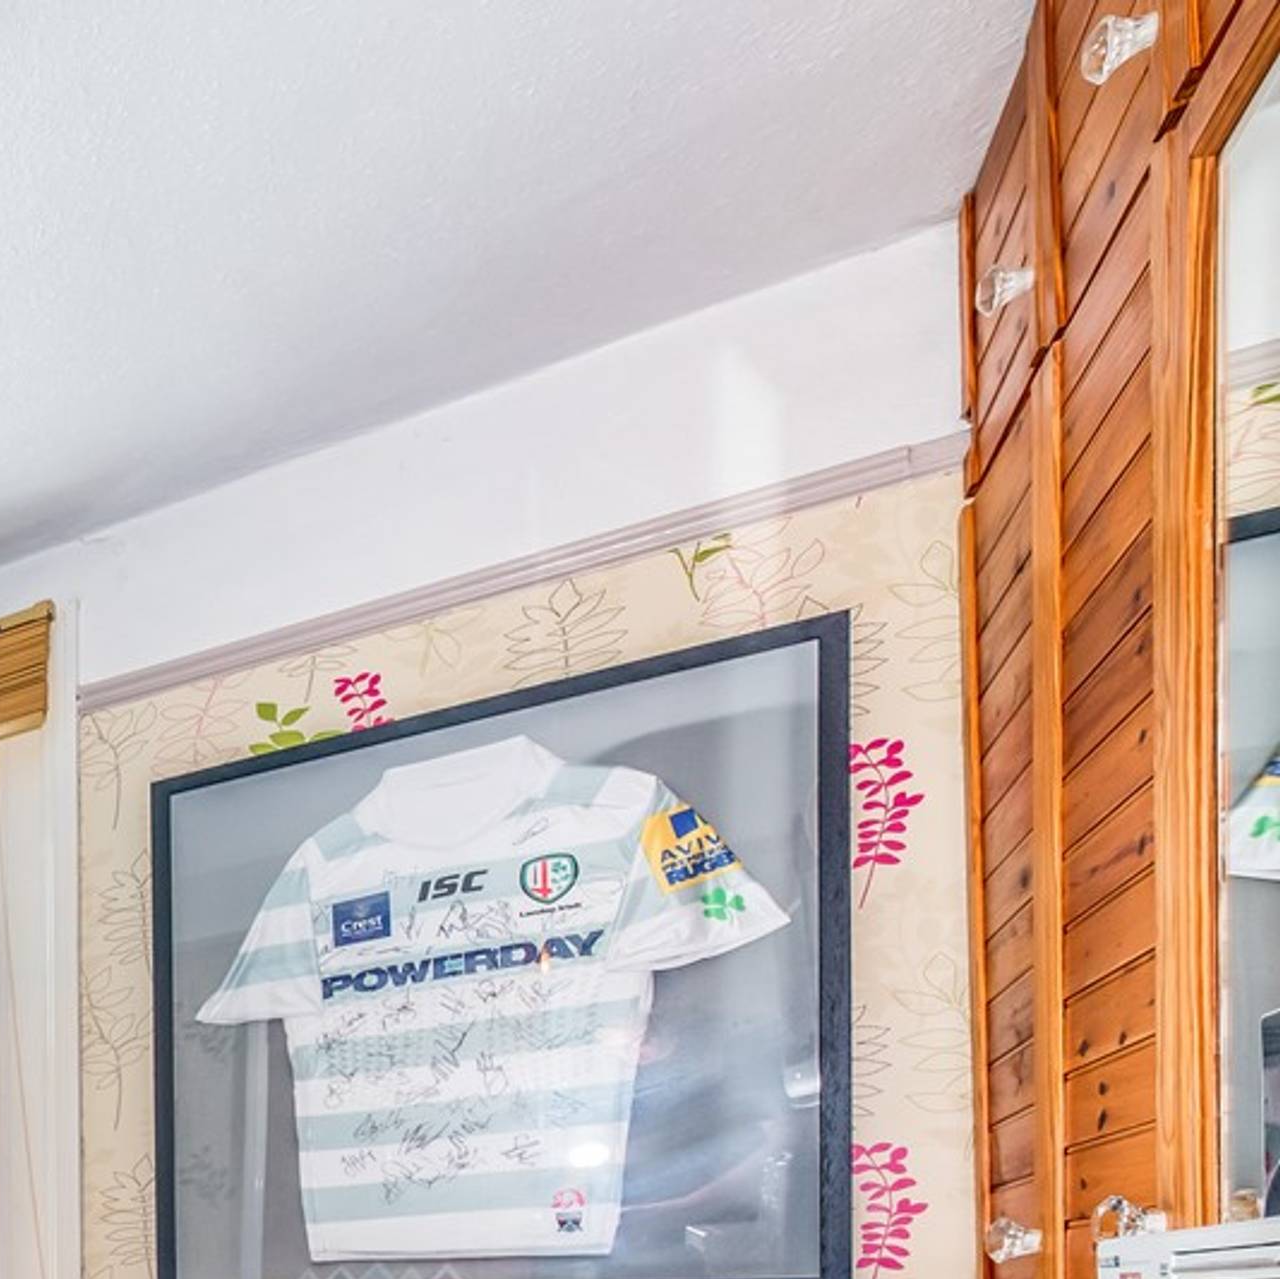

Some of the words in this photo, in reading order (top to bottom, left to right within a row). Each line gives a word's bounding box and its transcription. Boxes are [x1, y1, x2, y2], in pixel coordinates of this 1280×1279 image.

[661, 834, 722, 863] AVIV
[417, 869, 489, 903] ISC
[341, 914, 383, 933] Crest
[320, 929, 605, 1001] POWERDAY
